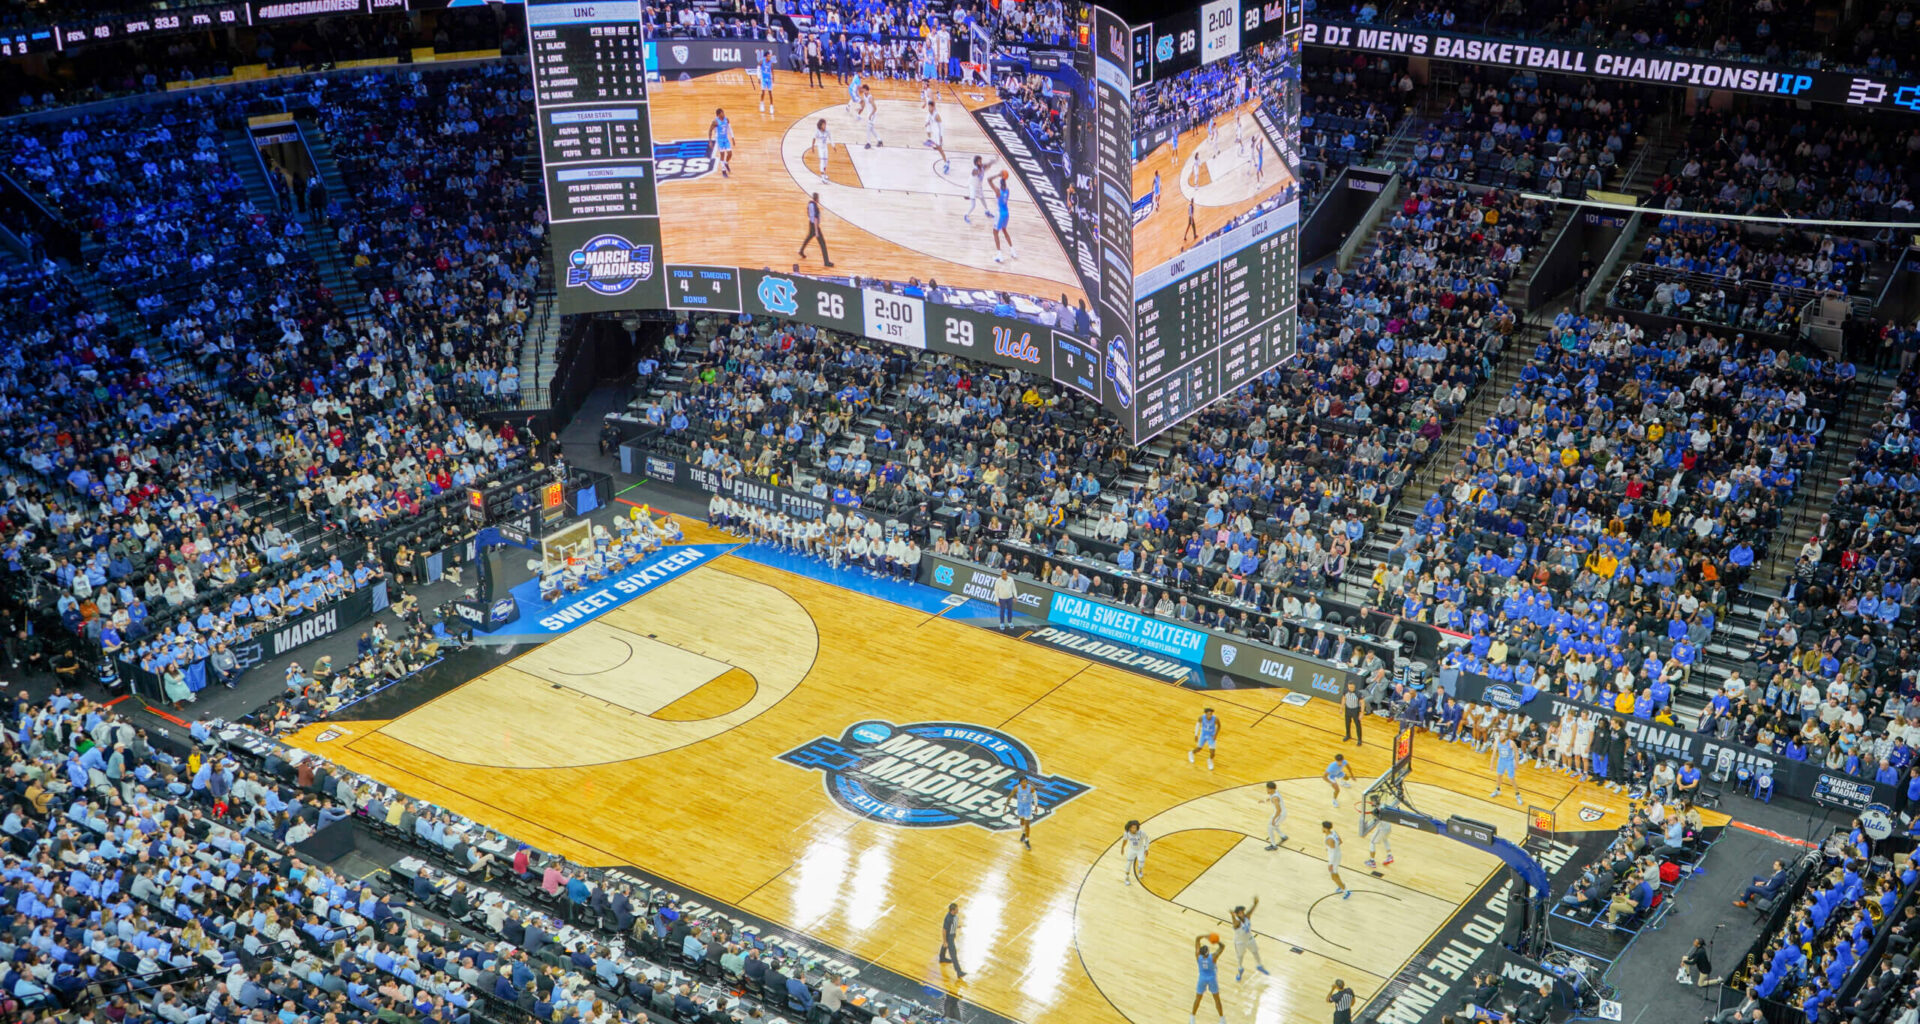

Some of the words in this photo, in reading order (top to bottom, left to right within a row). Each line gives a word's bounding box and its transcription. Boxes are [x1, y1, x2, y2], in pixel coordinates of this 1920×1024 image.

[219, 10, 236, 23] 50
[259, 0, 360, 19] #MARCHMADNESS
[574, 7, 595, 18] UNC
[154, 16, 180, 29] 33.3
[1208, 7, 1233, 33] 2:00
[1244, 7, 1260, 32] 29
[94, 25, 110, 38] 48
[533, 29, 557, 39] PLAYER
[18, 42, 28, 54] 3
[546, 41, 567, 50] BLACK
[608, 39, 614, 47] 1
[633, 38, 639, 47] 0
[1179, 29, 1196, 55] 26
[1214, 34, 1227, 50] 1ST
[547, 54, 563, 63] LOVE
[610, 51, 615, 59] 1
[635, 51, 640, 59] 1
[712, 48, 742, 63] UCLA
[1323, 25, 1352, 47] DI
[1356, 28, 1429, 55] MEN'S
[1434, 37, 1588, 73] BASKETBALL
[1595, 53, 1813, 96] CHAMPIONSHIP
[610, 63, 616, 71] 7
[624, 63, 630, 71] 1
[635, 63, 641, 71] 0
[550, 78, 578, 87] JOHNSON
[551, 90, 573, 99] MANEK
[638, 87, 643, 95] 1
[577, 112, 594, 120] TEAM
[594, 111, 612, 119] STATS
[980, 112, 1013, 129] THE
[992, 128, 1033, 158] ROAD
[1014, 156, 1044, 174] TO
[591, 182, 623, 191] TURNOVERS
[1025, 172, 1060, 199] THE
[1351, 180, 1367, 190] 102
[603, 193, 624, 201] POINTS
[606, 204, 625, 212] BENCH
[1585, 213, 1599, 224] 101
[1251, 220, 1268, 238] UCLA
[585, 249, 630, 266] MARCH
[592, 261, 650, 277] MADNESS
[673, 270, 694, 278] FOULS
[699, 271, 731, 280] TIMEOUTS
[1170, 259, 1186, 277] UNC
[680, 279, 689, 293] 4
[712, 280, 721, 294] 4
[683, 295, 707, 304] BONUS
[816, 290, 845, 320] 26
[874, 297, 913, 323] 2:00
[887, 323, 903, 337] 1ST
[944, 316, 975, 347] 29
[992, 325, 1041, 364] Ucla
[1066, 353, 1074, 368] 4
[1087, 363, 1094, 378] 3
[689, 467, 707, 483] THE
[733, 480, 778, 511] FINAL
[780, 492, 826, 523] FOUR
[971, 571, 999, 588] NORT
[539, 585, 619, 631] SWEET
[613, 547, 706, 594] SIXTEEN
[1016, 592, 1043, 607] ACC
[1054, 594, 1091, 619] NCAA
[1092, 606, 1142, 633] SWEET
[1141, 619, 1202, 651] SIXTEEN
[273, 608, 338, 655] MARCH
[1068, 616, 1090, 628] HOSTED
[1090, 623, 1098, 631] BY
[1098, 624, 1132, 640] UNIVERSITY
[1131, 634, 1139, 643] OF
[1139, 637, 1182, 655] PENNSYLVANIA
[1030, 626, 1194, 680] PHILADELPHIA
[1259, 658, 1295, 682] UCLA
[1311, 672, 1340, 695] Ucla
[1552, 700, 1580, 718] THE
[856, 727, 888, 743] NCAA
[943, 728, 993, 746] SWEET
[992, 738, 1013, 752] 16
[1624, 720, 1695, 762] FINAL
[1700, 742, 1777, 782] FOUR
[875, 733, 1018, 787] MARCH
[860, 757, 1046, 826] MADNESS
[1828, 778, 1858, 792] MARCH
[1830, 785, 1871, 803] MADNESS
[851, 793, 896, 816] ELITE
[893, 807, 905, 819] 8
[1863, 817, 1885, 832] Ucla
[1462, 914, 1504, 944] TO
[1427, 939, 1485, 982] THE
[1501, 961, 1554, 994] NCAA
